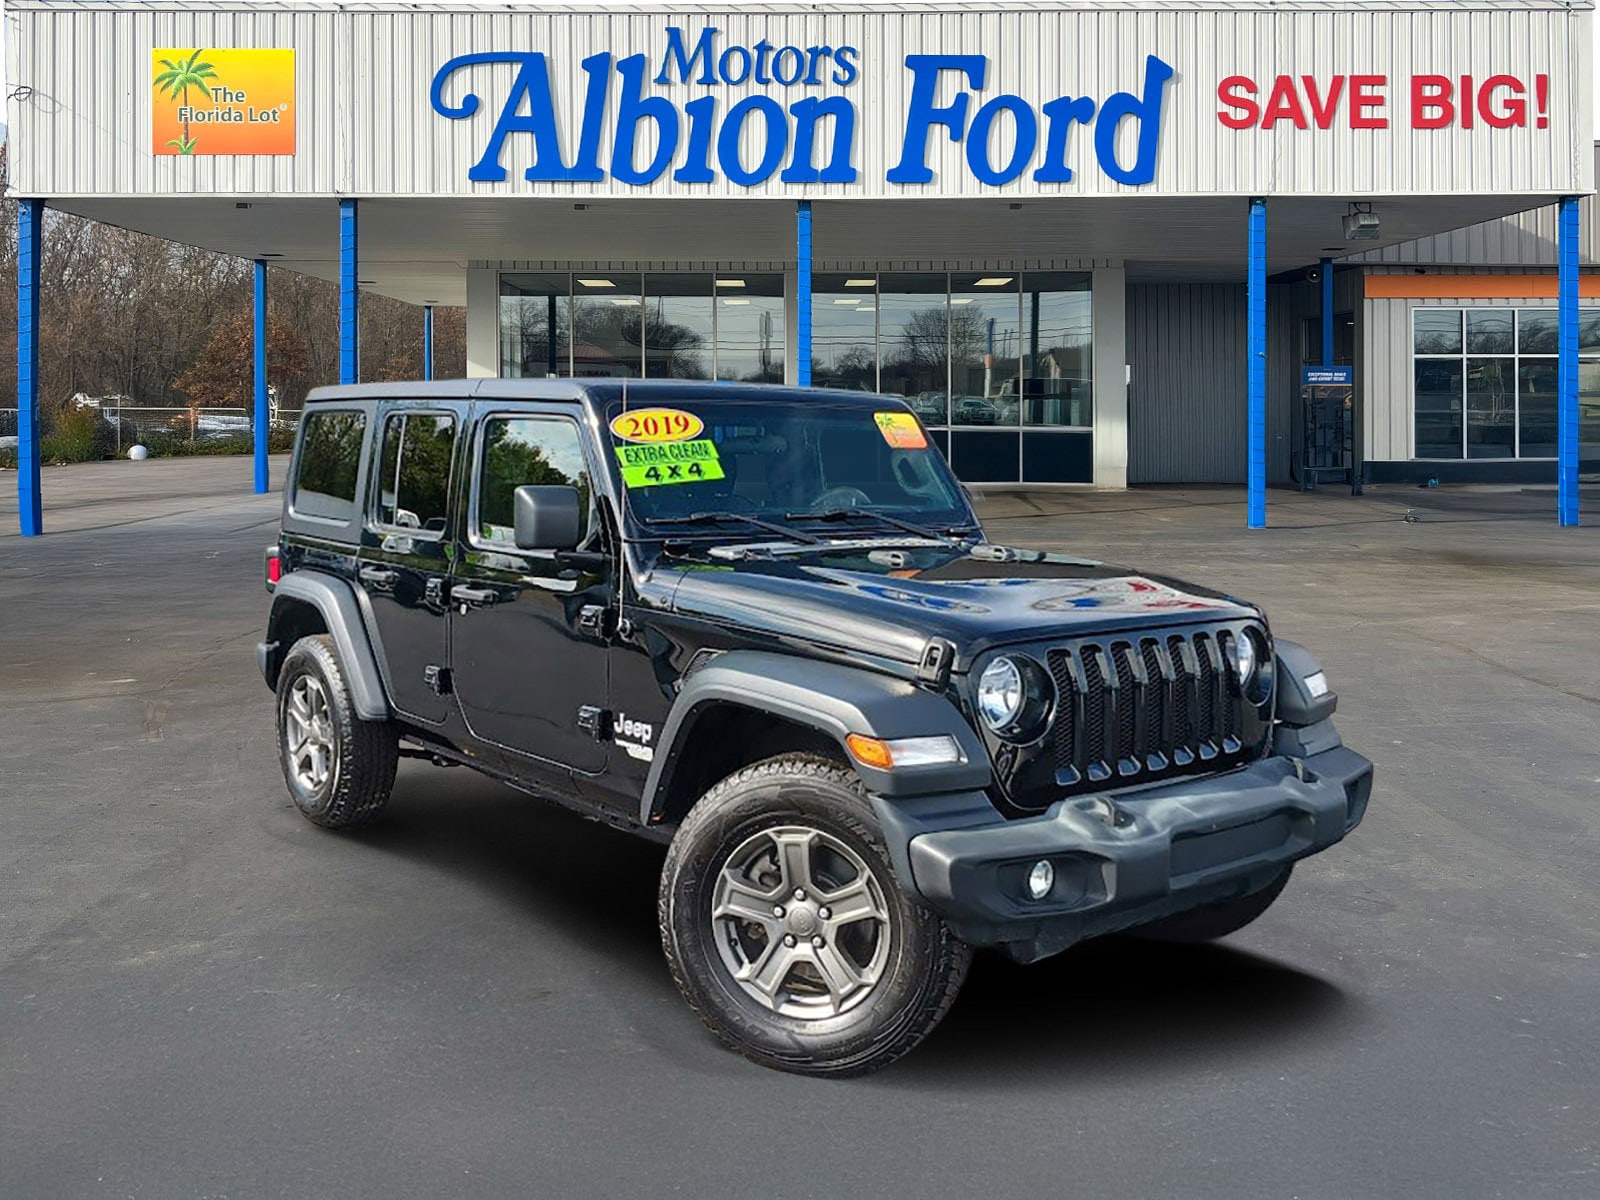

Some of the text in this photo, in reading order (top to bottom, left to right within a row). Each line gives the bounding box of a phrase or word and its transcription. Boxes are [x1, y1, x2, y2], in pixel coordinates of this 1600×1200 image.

[653, 27, 858, 86] Motors
[210, 86, 246, 103] The
[1217, 74, 1548, 129] SAVE BIG!
[178, 106, 279, 122] Florida Lot
[430, 52, 1173, 186] Albion Ford
[627, 415, 690, 437] 2019
[624, 442, 710, 464] EXTRA CLEAN
[613, 712, 652, 744] Jeep
